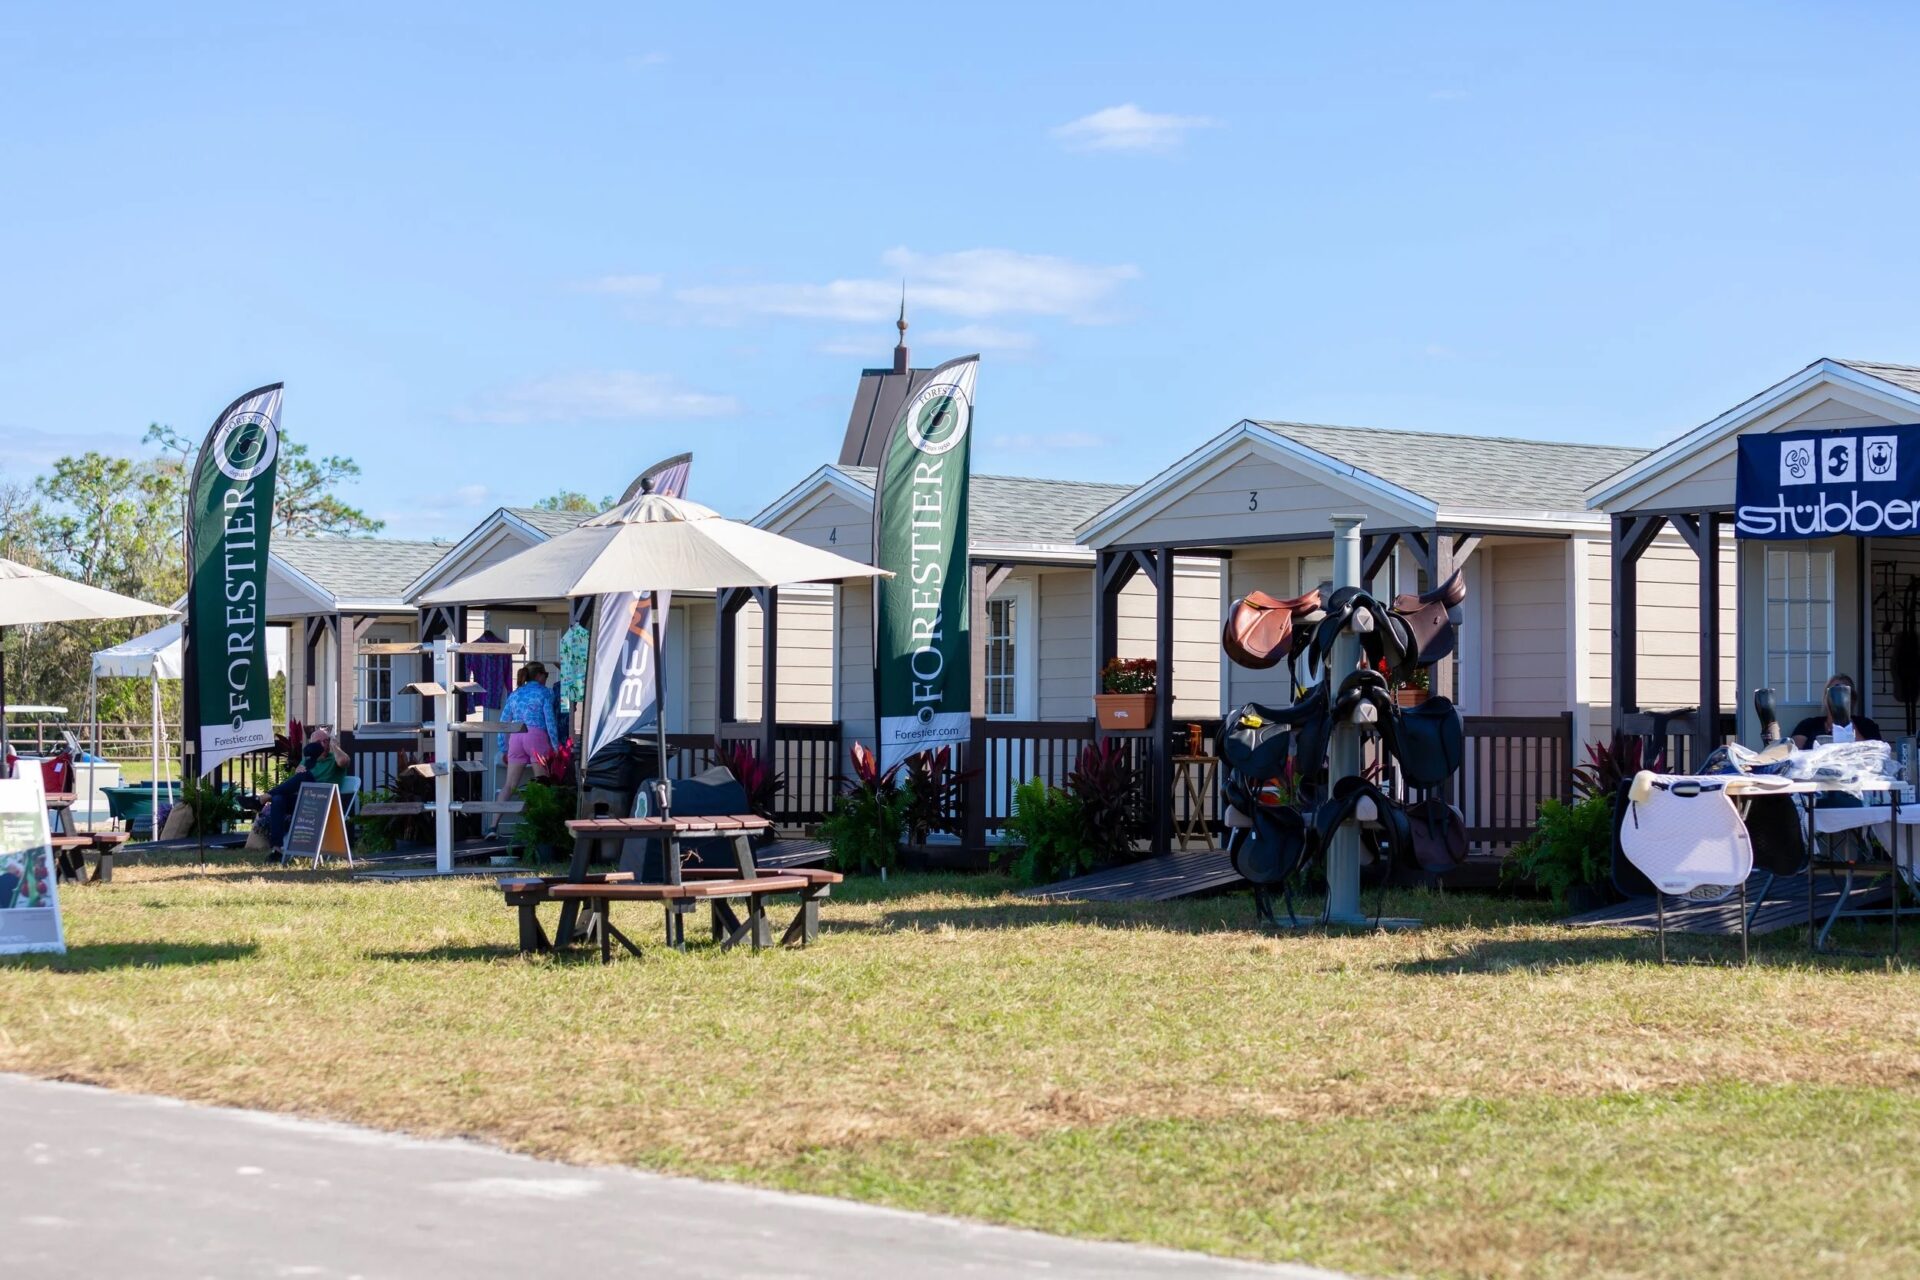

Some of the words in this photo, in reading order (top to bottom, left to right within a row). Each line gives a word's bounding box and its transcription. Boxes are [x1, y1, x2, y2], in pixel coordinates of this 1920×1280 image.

[1249, 491, 1258, 512] 3
[829, 527, 837, 545] 4
[911, 458, 943, 705] FORESTIER
[224, 482, 256, 714] FORESTIER
[214, 733, 264, 746] Forestier.com
[895, 727, 959, 739] Forestier.com
